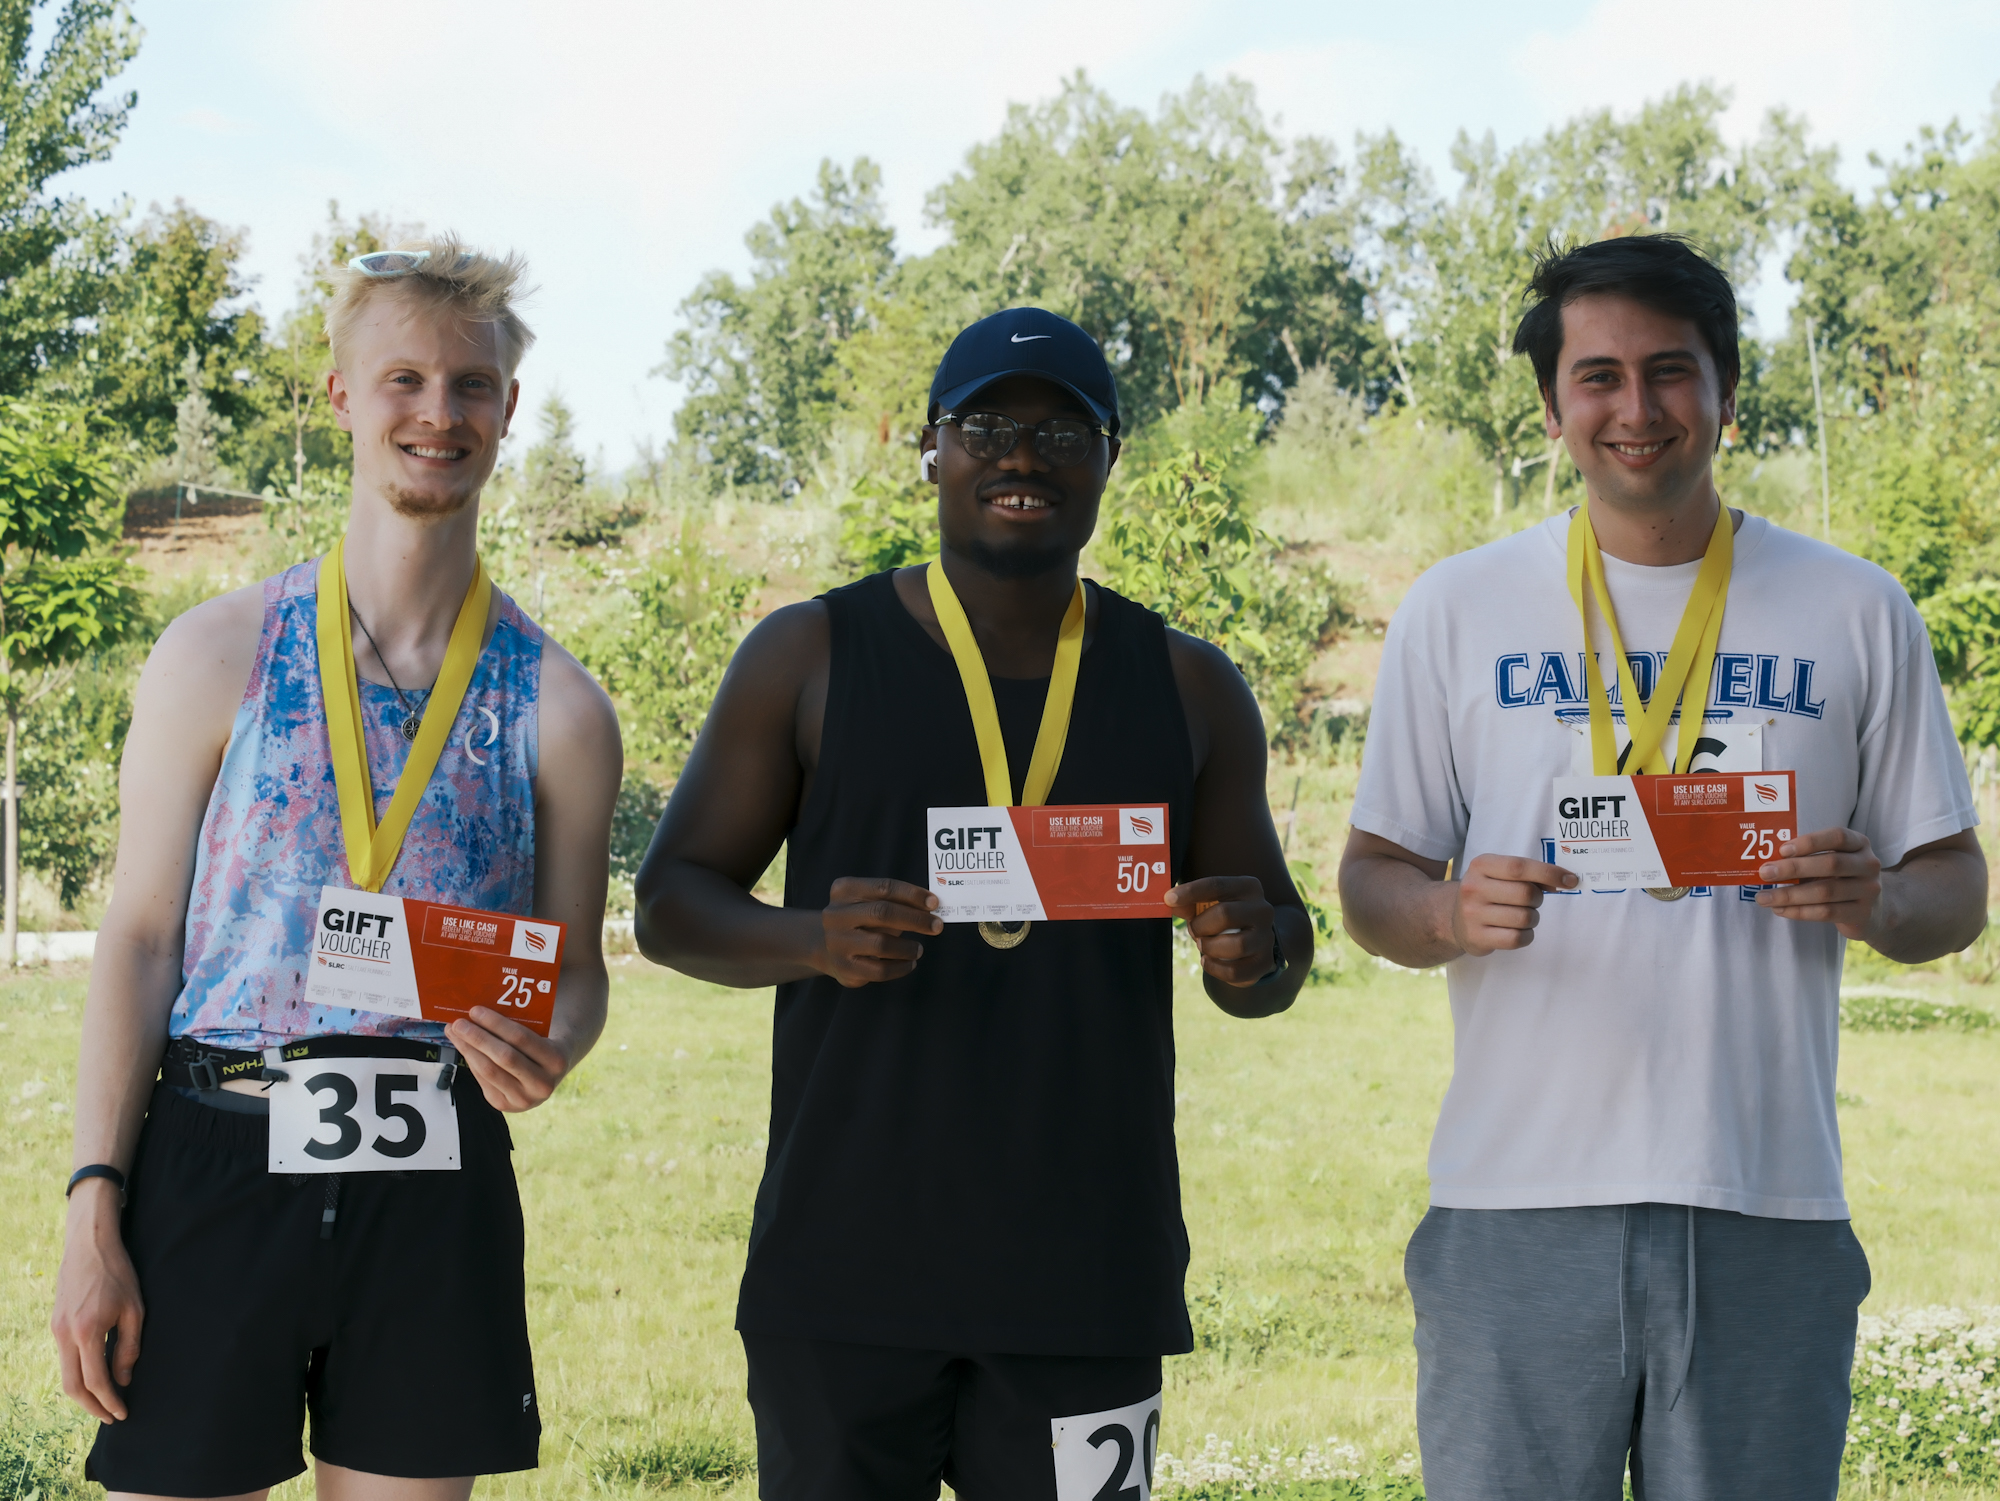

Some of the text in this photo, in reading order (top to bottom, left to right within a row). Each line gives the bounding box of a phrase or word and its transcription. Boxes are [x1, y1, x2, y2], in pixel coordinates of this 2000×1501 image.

[1495, 651, 1826, 720] CALDELL
[1673, 784, 1727, 794] USE LIKE CASH
[1558, 796, 1626, 819] GIFT
[1049, 816, 1103, 826] USE LIKE CASH
[1558, 820, 1629, 839] VOUCHER
[934, 827, 1002, 850] GIFT
[1740, 829, 1774, 860] 25
[934, 852, 1005, 870] VOUCHER
[1117, 862, 1149, 893] 50
[323, 908, 394, 938] GIFT
[443, 916, 498, 932] USE LIKE CASH
[473, 930, 496, 939] VOUCHER
[320, 932, 391, 959] VOUCHER
[502, 967, 518, 975] VALUE
[496, 975, 535, 1008] 25
[302, 1072, 427, 1161] 35
[1086, 1408, 1160, 1500] 20
